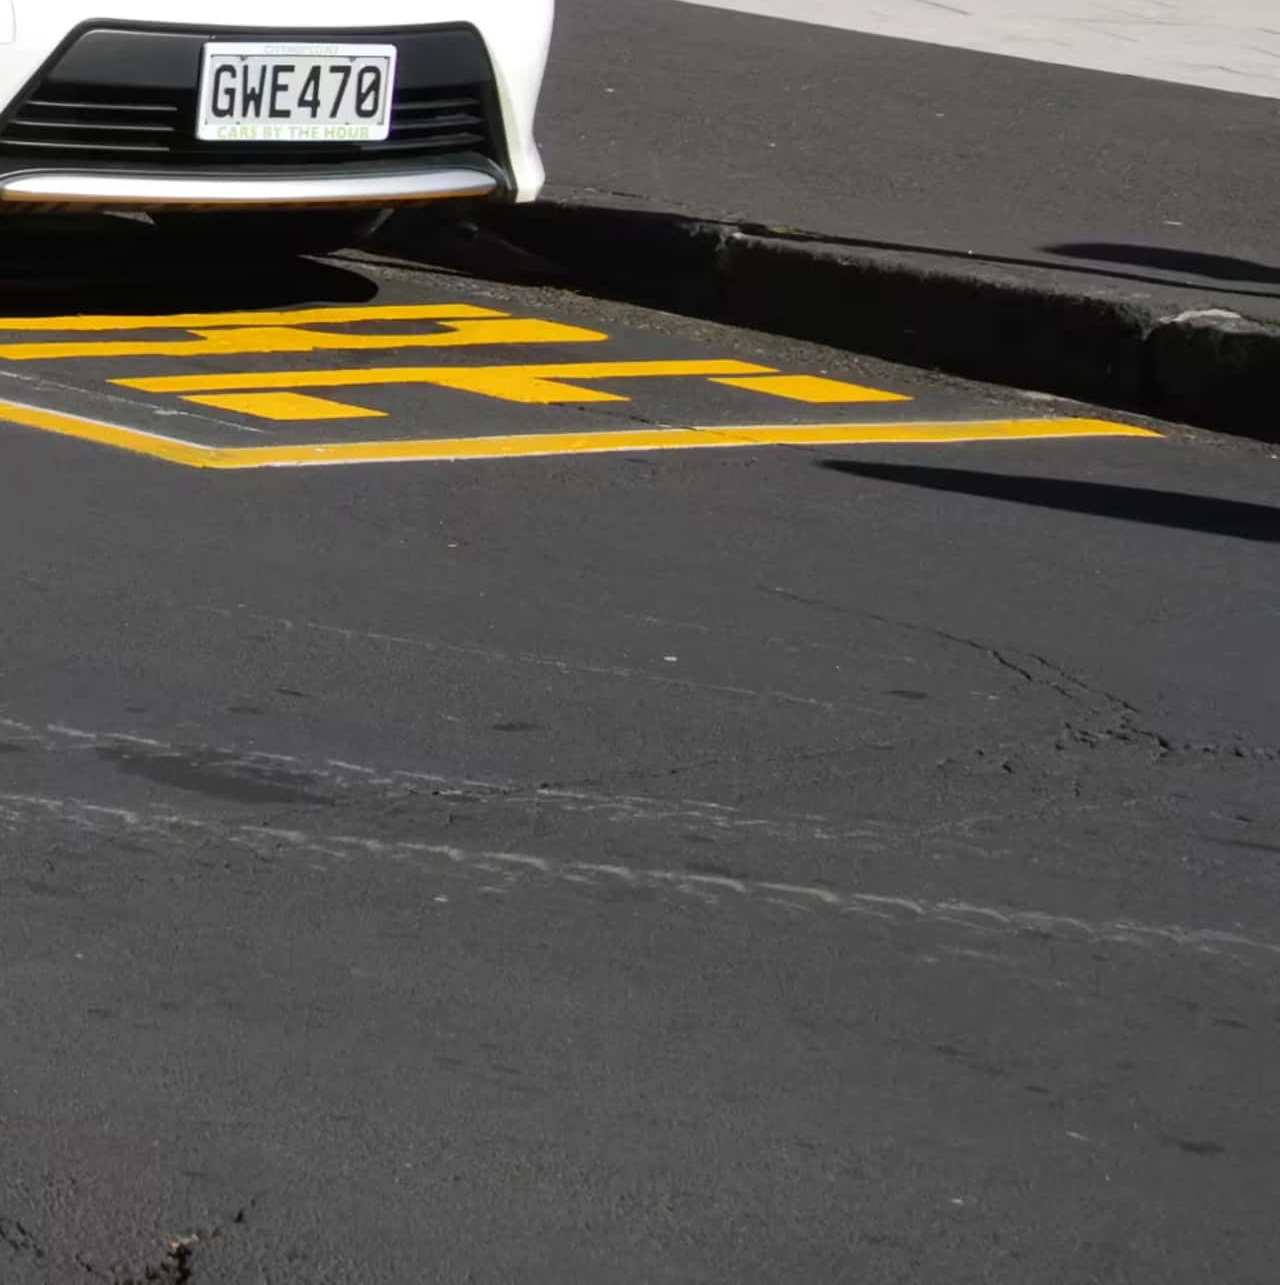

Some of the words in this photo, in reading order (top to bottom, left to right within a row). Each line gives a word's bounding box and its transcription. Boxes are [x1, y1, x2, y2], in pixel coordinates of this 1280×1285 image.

[210, 63, 382, 119] GWE470
[216, 125, 257, 139] CARS
[287, 126, 321, 139] THE
[324, 126, 370, 140] HOUR
